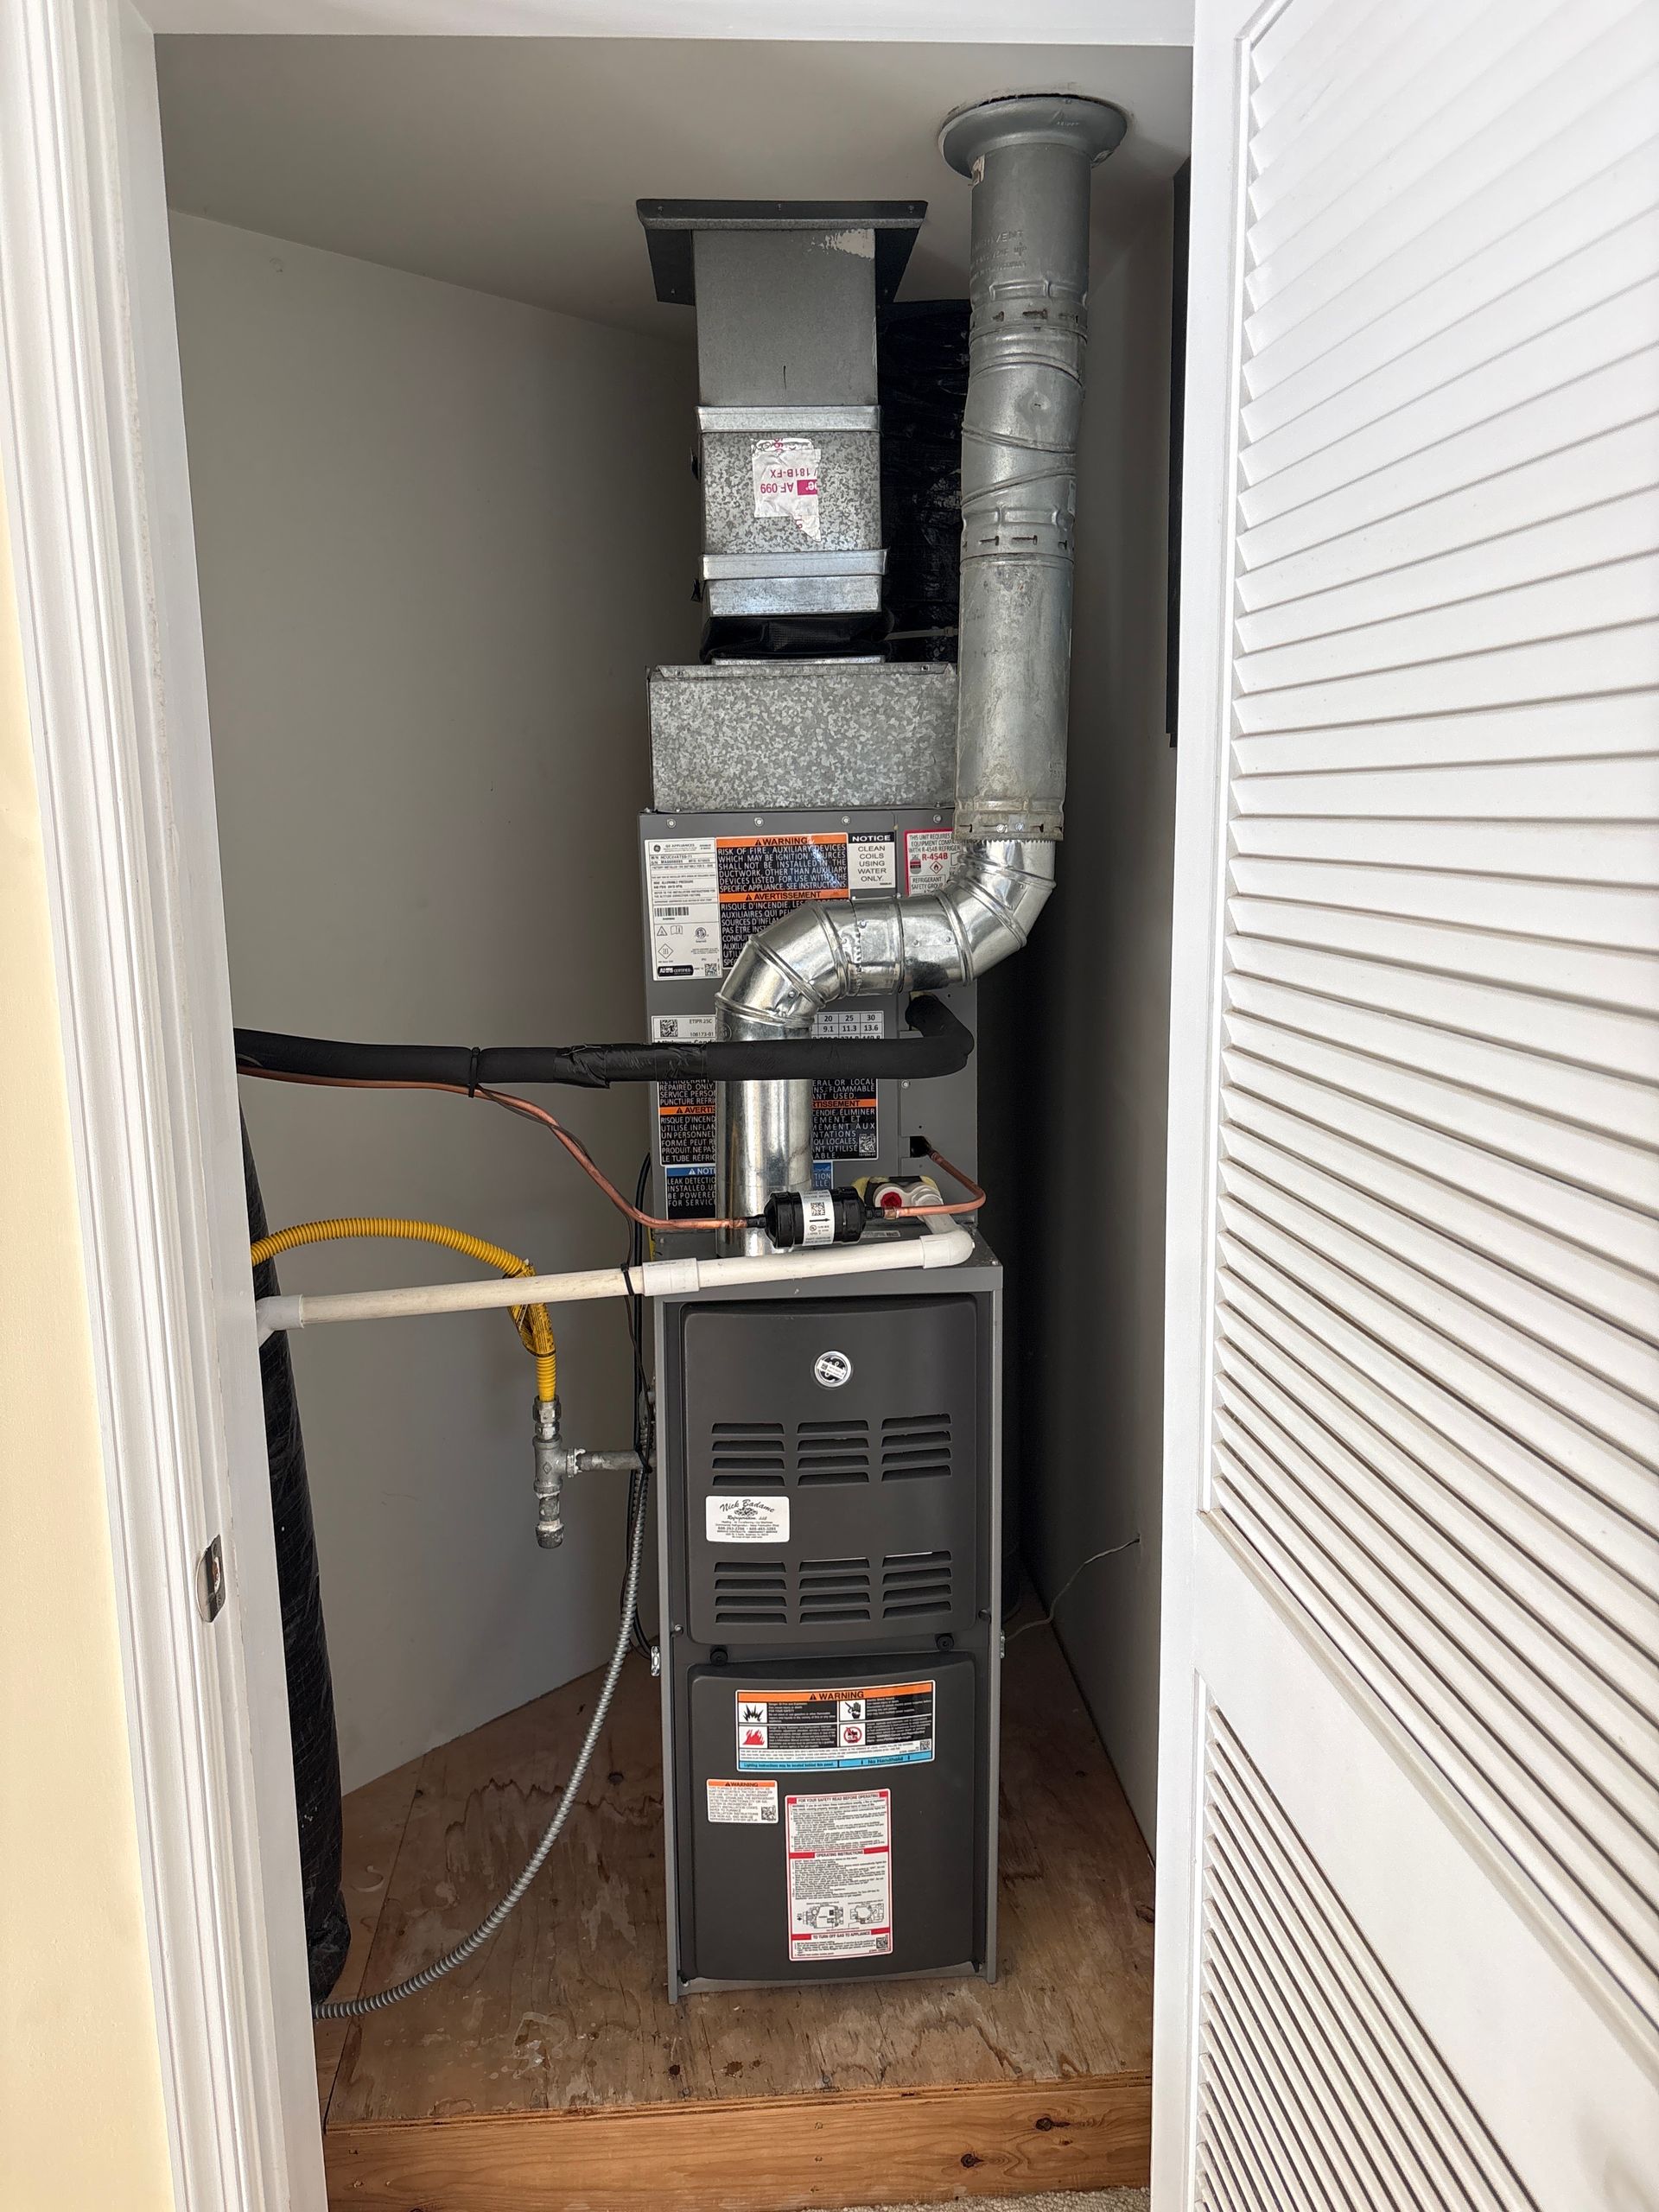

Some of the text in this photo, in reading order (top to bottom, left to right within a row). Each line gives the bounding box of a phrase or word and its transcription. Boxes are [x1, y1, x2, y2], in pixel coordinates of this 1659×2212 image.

[771, 467, 810, 478] 181B-FX
[760, 482, 794, 493] AF 099
[763, 837, 808, 846] WARNING
[772, 845, 812, 855] AUXILIARY
[815, 843, 846, 852] DEVICES
[718, 855, 743, 863] WHICH
[776, 853, 809, 861] IGNITION
[922, 852, 949, 861] R-454B
[718, 862, 742, 871] SHALL
[777, 860, 817, 868] INSTALLED
[811, 866, 847, 874] AUXILIARY
[719, 877, 750, 886] DEVICES
[752, 876, 775, 885] LISTED
[748, 883, 785, 892] APPLIANCE.
[753, 891, 822, 900] AVERTISSEMENT
[721, 903, 747, 912] RISQUE
[721, 910, 763, 918] AUXILIAIRES
[721, 918, 751, 926] SOURCES
[735, 924, 750, 933] ÊTRE
[660, 1090, 689, 1099] SERVICE
[660, 1097, 695, 1106] PUNCTURE
[840, 1107, 875, 1116] ÉLIMINER
[661, 1123, 688, 1133] UTILISÉ
[814, 1130, 856, 1139] NTATIONS
[661, 1137, 688, 1147] FORMÉ
[829, 1143, 858, 1152] UTILISÉ
[668, 1177, 683, 1185] LEAK
[668, 1199, 682, 1208] FOR
[719, 1500, 740, 1512] Nick
[818, 1691, 864, 1700] WARNING
